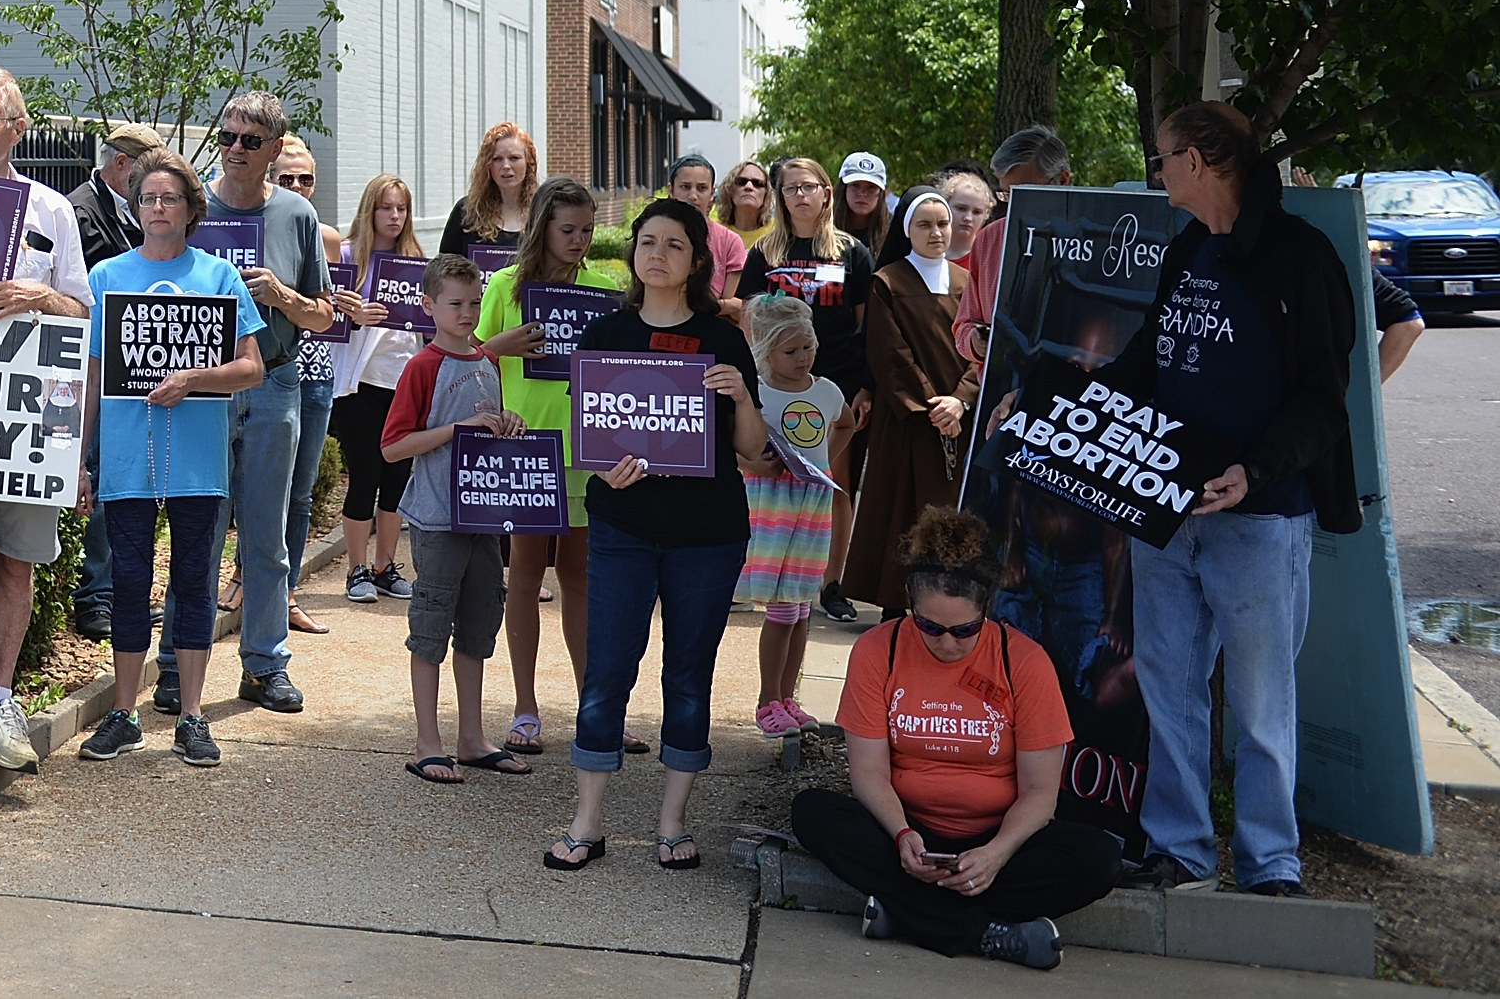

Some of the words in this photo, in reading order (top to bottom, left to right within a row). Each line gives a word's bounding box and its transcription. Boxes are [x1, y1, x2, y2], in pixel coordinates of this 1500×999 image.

[1023, 227, 1036, 256] I
[1051, 237, 1093, 262] was
[121, 303, 224, 323] ABORTION
[535, 308, 540, 319] I
[549, 308, 577, 321] AM
[1212, 301, 1220, 310] a
[121, 321, 223, 345] BETRAYS
[121, 344, 222, 369] WOMEN
[601, 357, 684, 366] STUDENTSFORLIFE.ORG
[583, 391, 704, 417] PRO-LIFE
[1079, 381, 1184, 439] PRAY
[583, 413, 704, 433] PRO-WOMAN
[1049, 395, 1097, 432] TO
[1098, 422, 1180, 471] END
[463, 454, 468, 467] I
[475, 455, 503, 469] AM
[511, 457, 550, 470] THE
[1000, 411, 1195, 513] ABORTION
[458, 469, 557, 490] PRO-LIFE
[460, 491, 556, 507] GENERATION
[1029, 461, 1073, 488] DAYS
[1070, 480, 1108, 508] FOR
[1105, 498, 1146, 526] LIFE
[967, 675, 1003, 703] LIFE
[921, 699, 948, 712] Setting
[950, 701, 963, 711] the
[897, 714, 957, 734] CAPTIVES
[960, 718, 990, 736] FREE
[943, 744, 960, 753] 4:18
